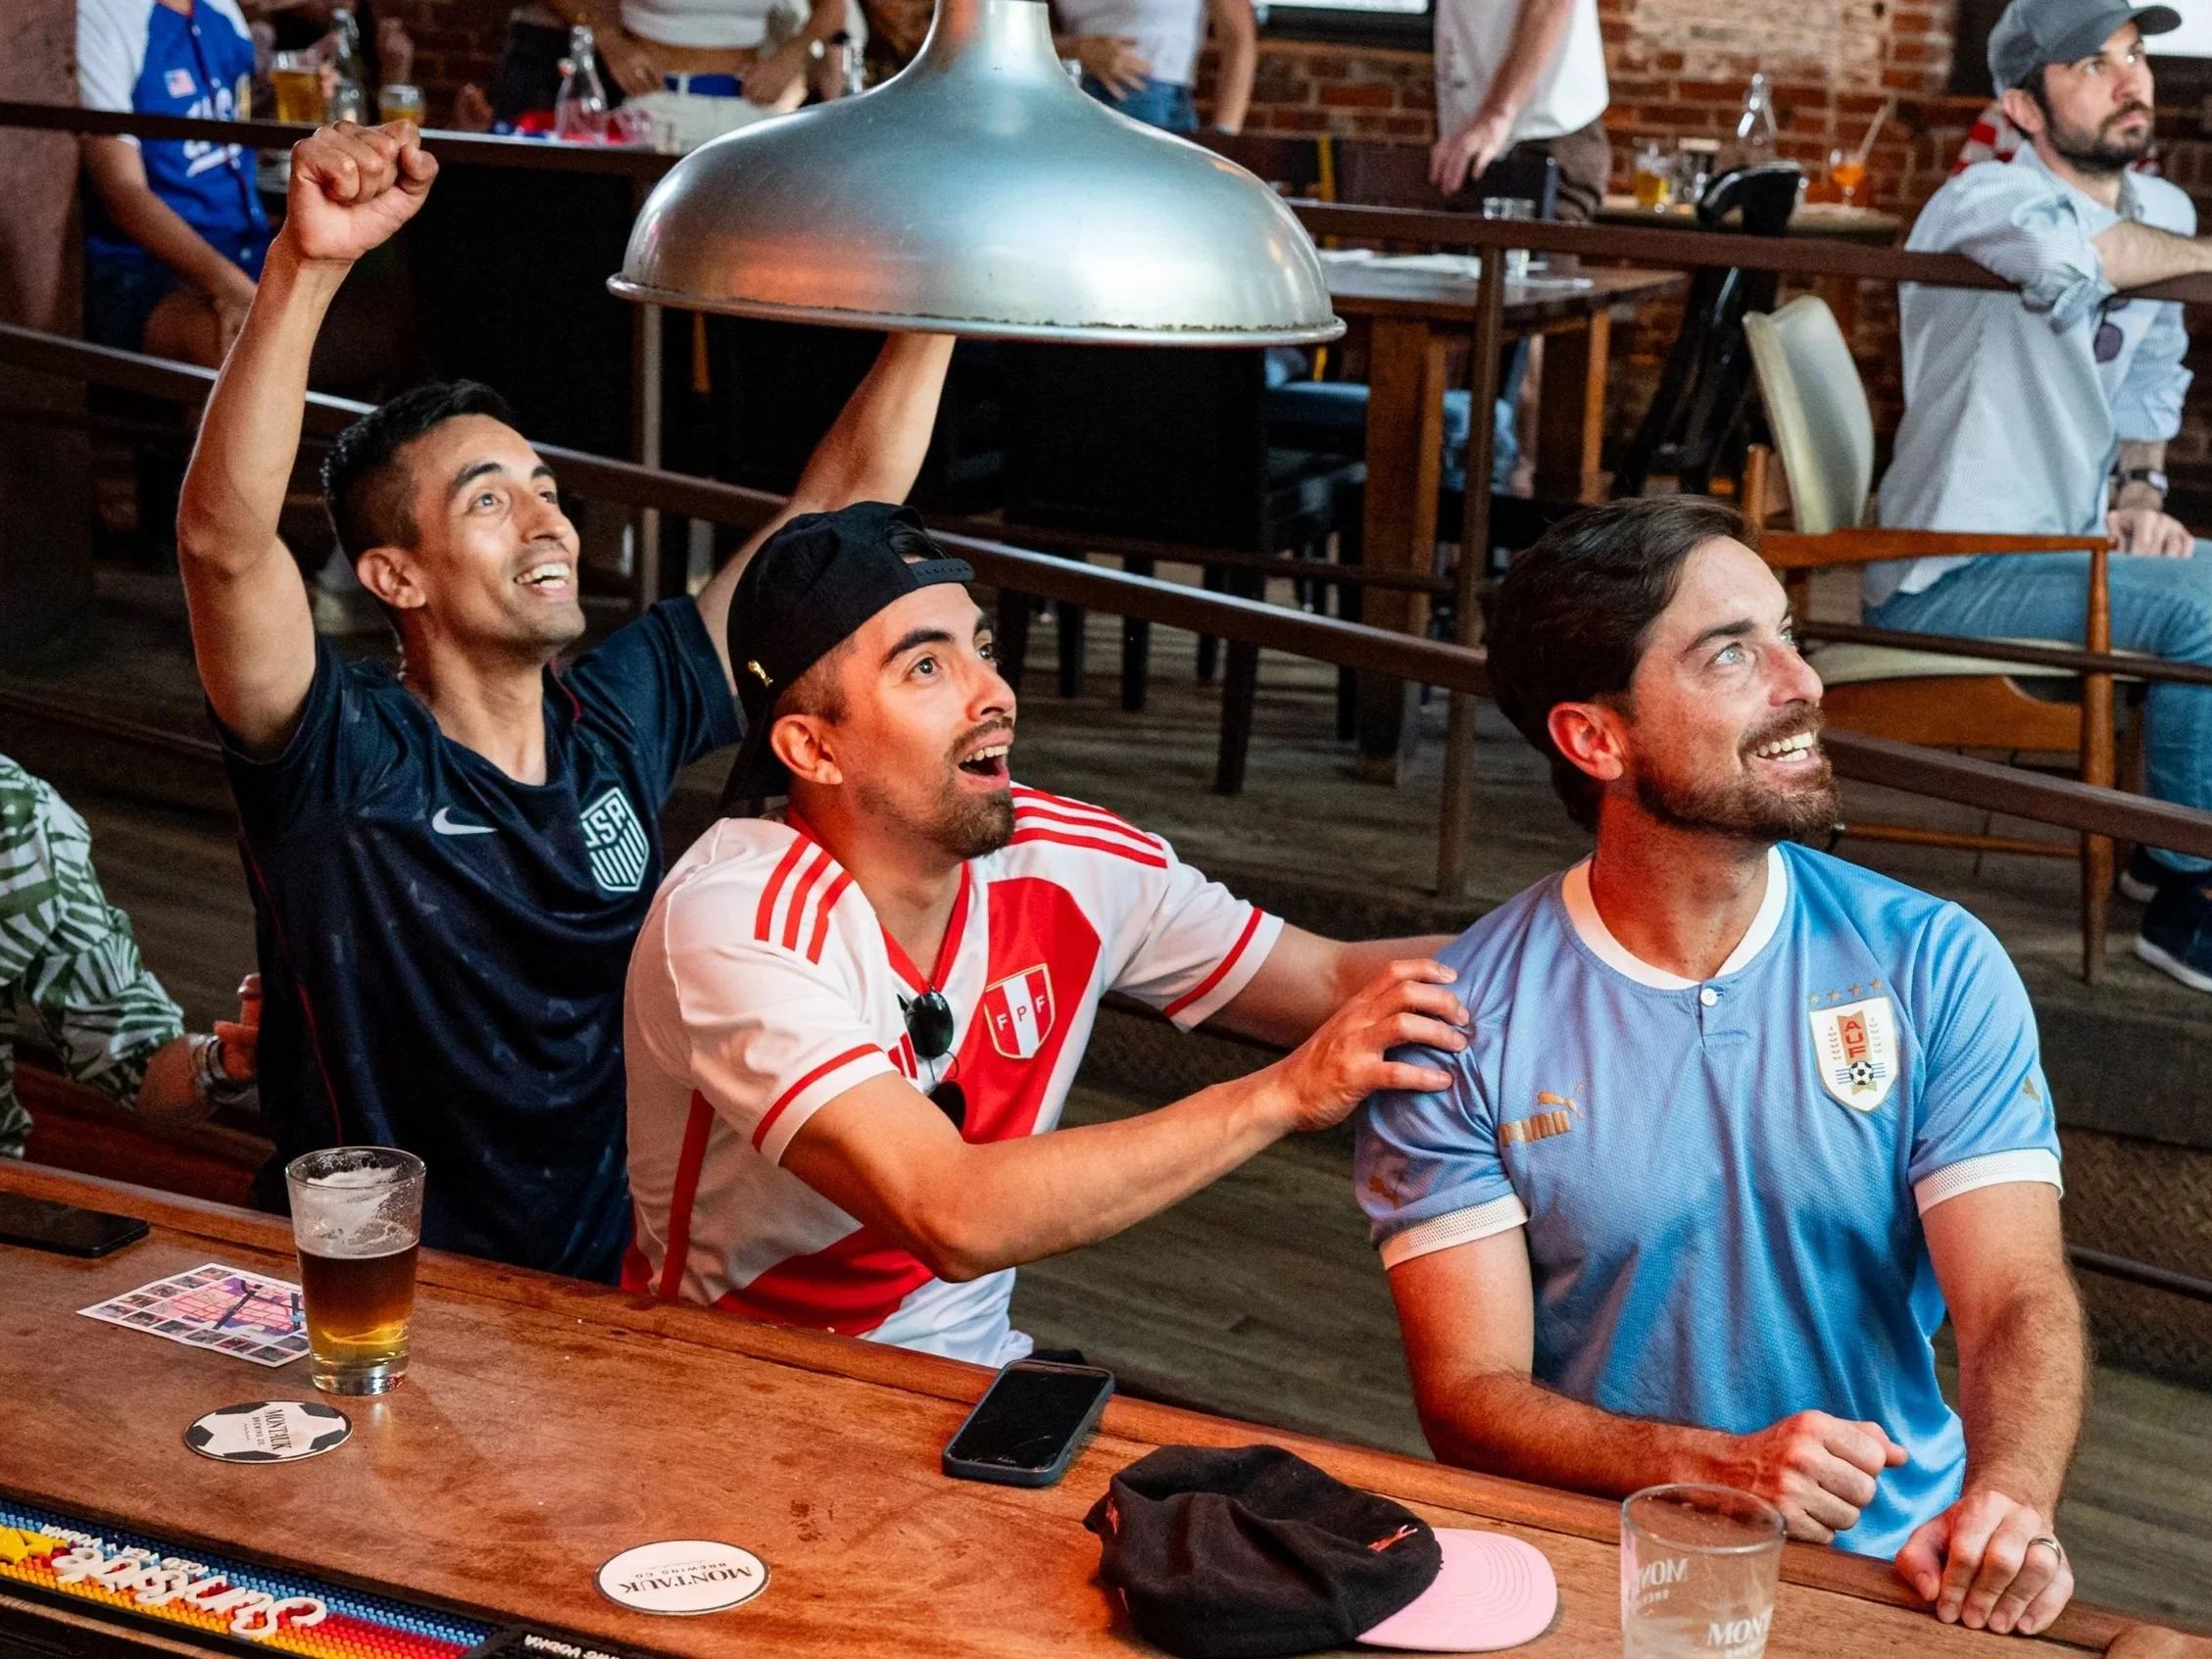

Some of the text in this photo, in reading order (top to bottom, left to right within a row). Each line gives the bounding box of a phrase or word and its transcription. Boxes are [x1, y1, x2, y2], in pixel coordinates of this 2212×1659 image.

[264, 1408, 292, 1450] MONTAUK
[618, 1566, 753, 1593] MONTAUK
[662, 1562, 726, 1575] BREWING
[524, 1634, 582, 1659] VODKA
